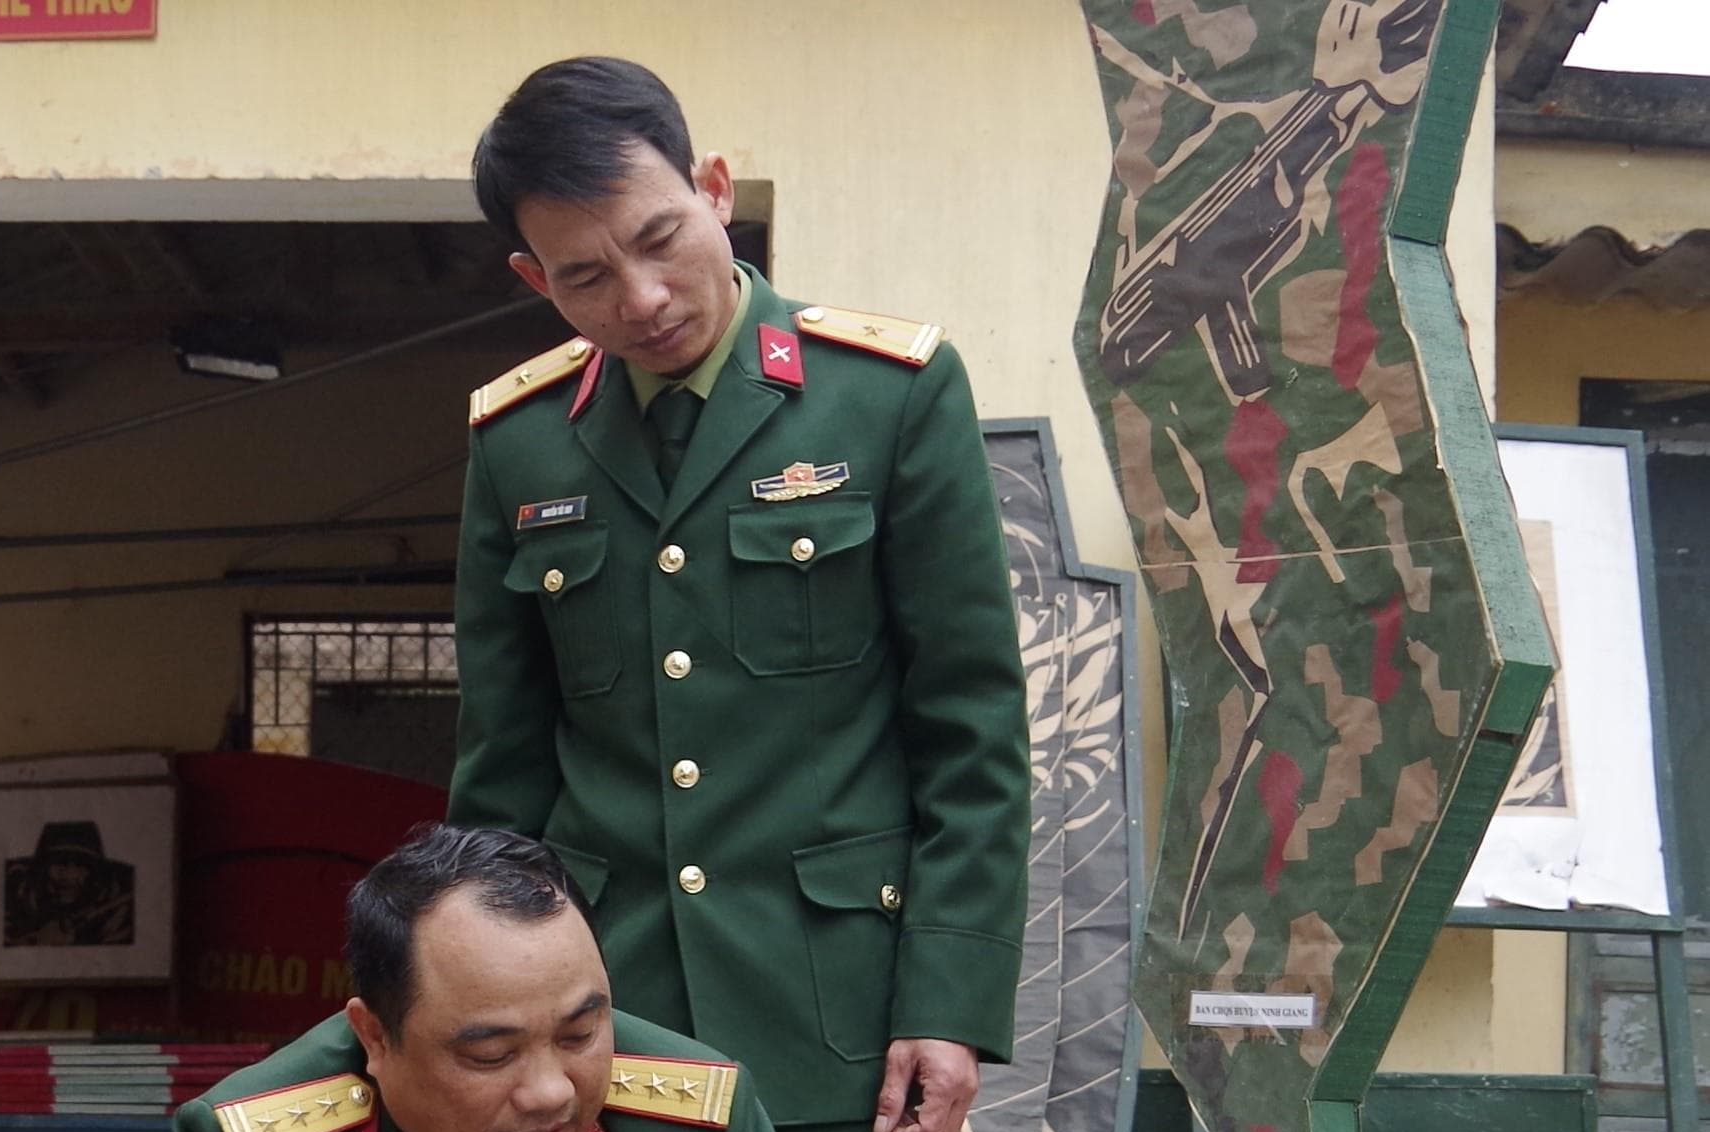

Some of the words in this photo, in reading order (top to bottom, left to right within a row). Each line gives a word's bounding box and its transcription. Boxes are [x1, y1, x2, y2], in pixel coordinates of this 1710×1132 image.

[1093, 591, 1107, 613] 7
[1036, 609, 1051, 629] 7
[1195, 1005, 1211, 1015] BAN
